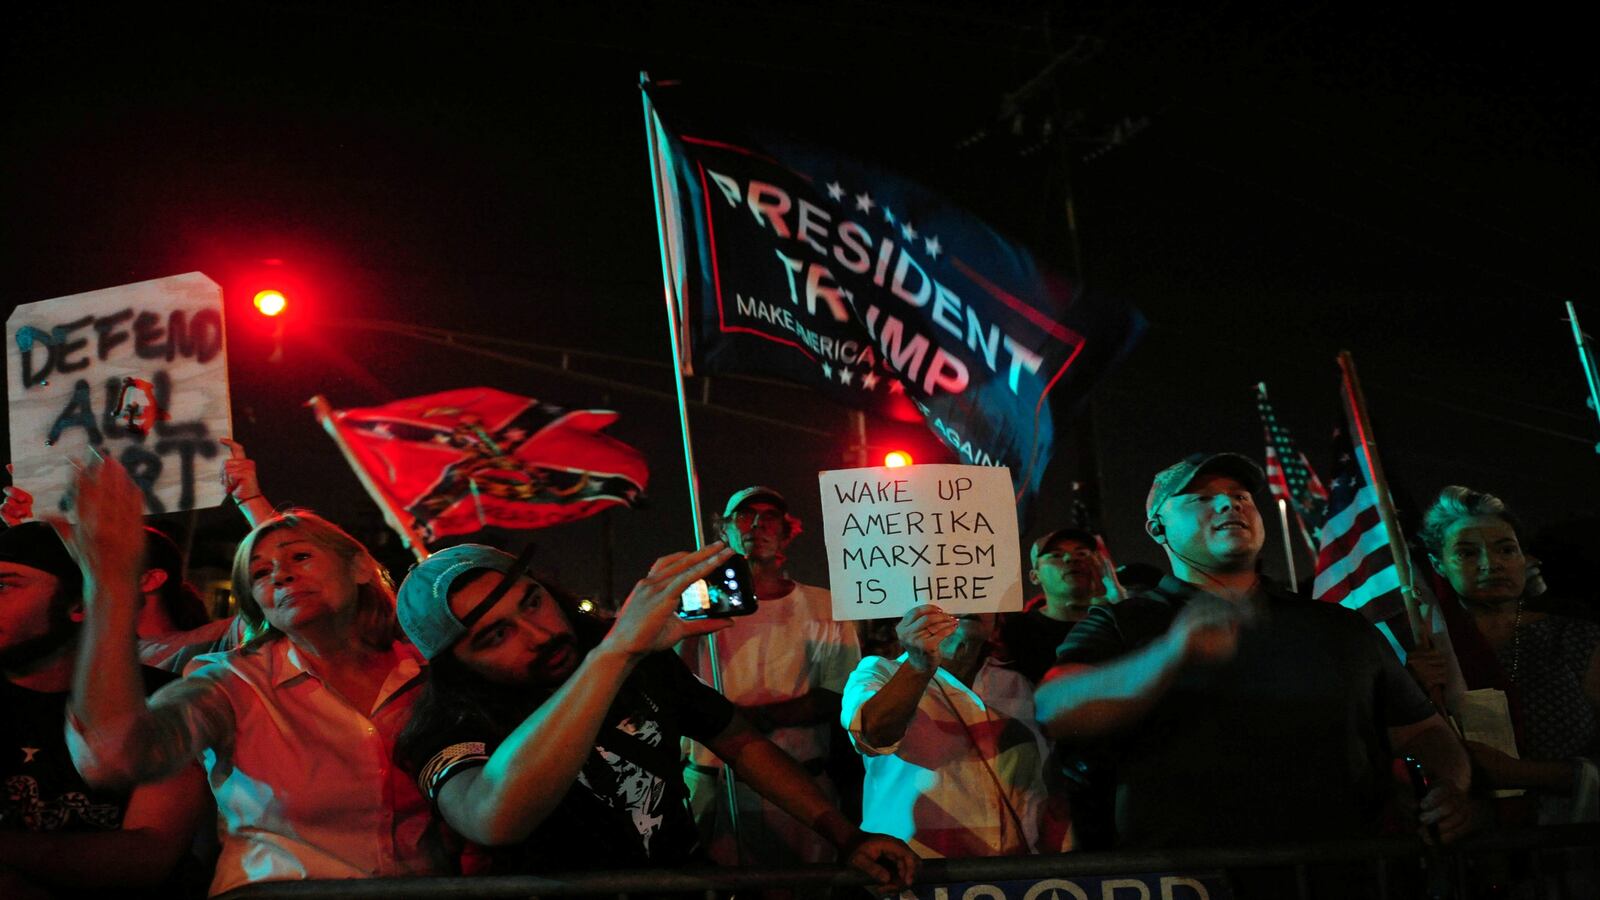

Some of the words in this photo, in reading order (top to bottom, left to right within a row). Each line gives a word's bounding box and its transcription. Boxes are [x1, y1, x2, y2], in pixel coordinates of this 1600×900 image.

[707, 168, 1042, 395] PRESIDENT
[736, 293, 796, 332] MAKE
[16, 308, 222, 389] DEFEND
[60, 440, 217, 512] RT
[835, 480, 913, 504] WAKE
[938, 477, 972, 501] UP
[842, 510, 995, 536] AMERIKA
[843, 544, 996, 570] MARXISM
[855, 579, 887, 605] IS
[913, 576, 994, 602] HERE
